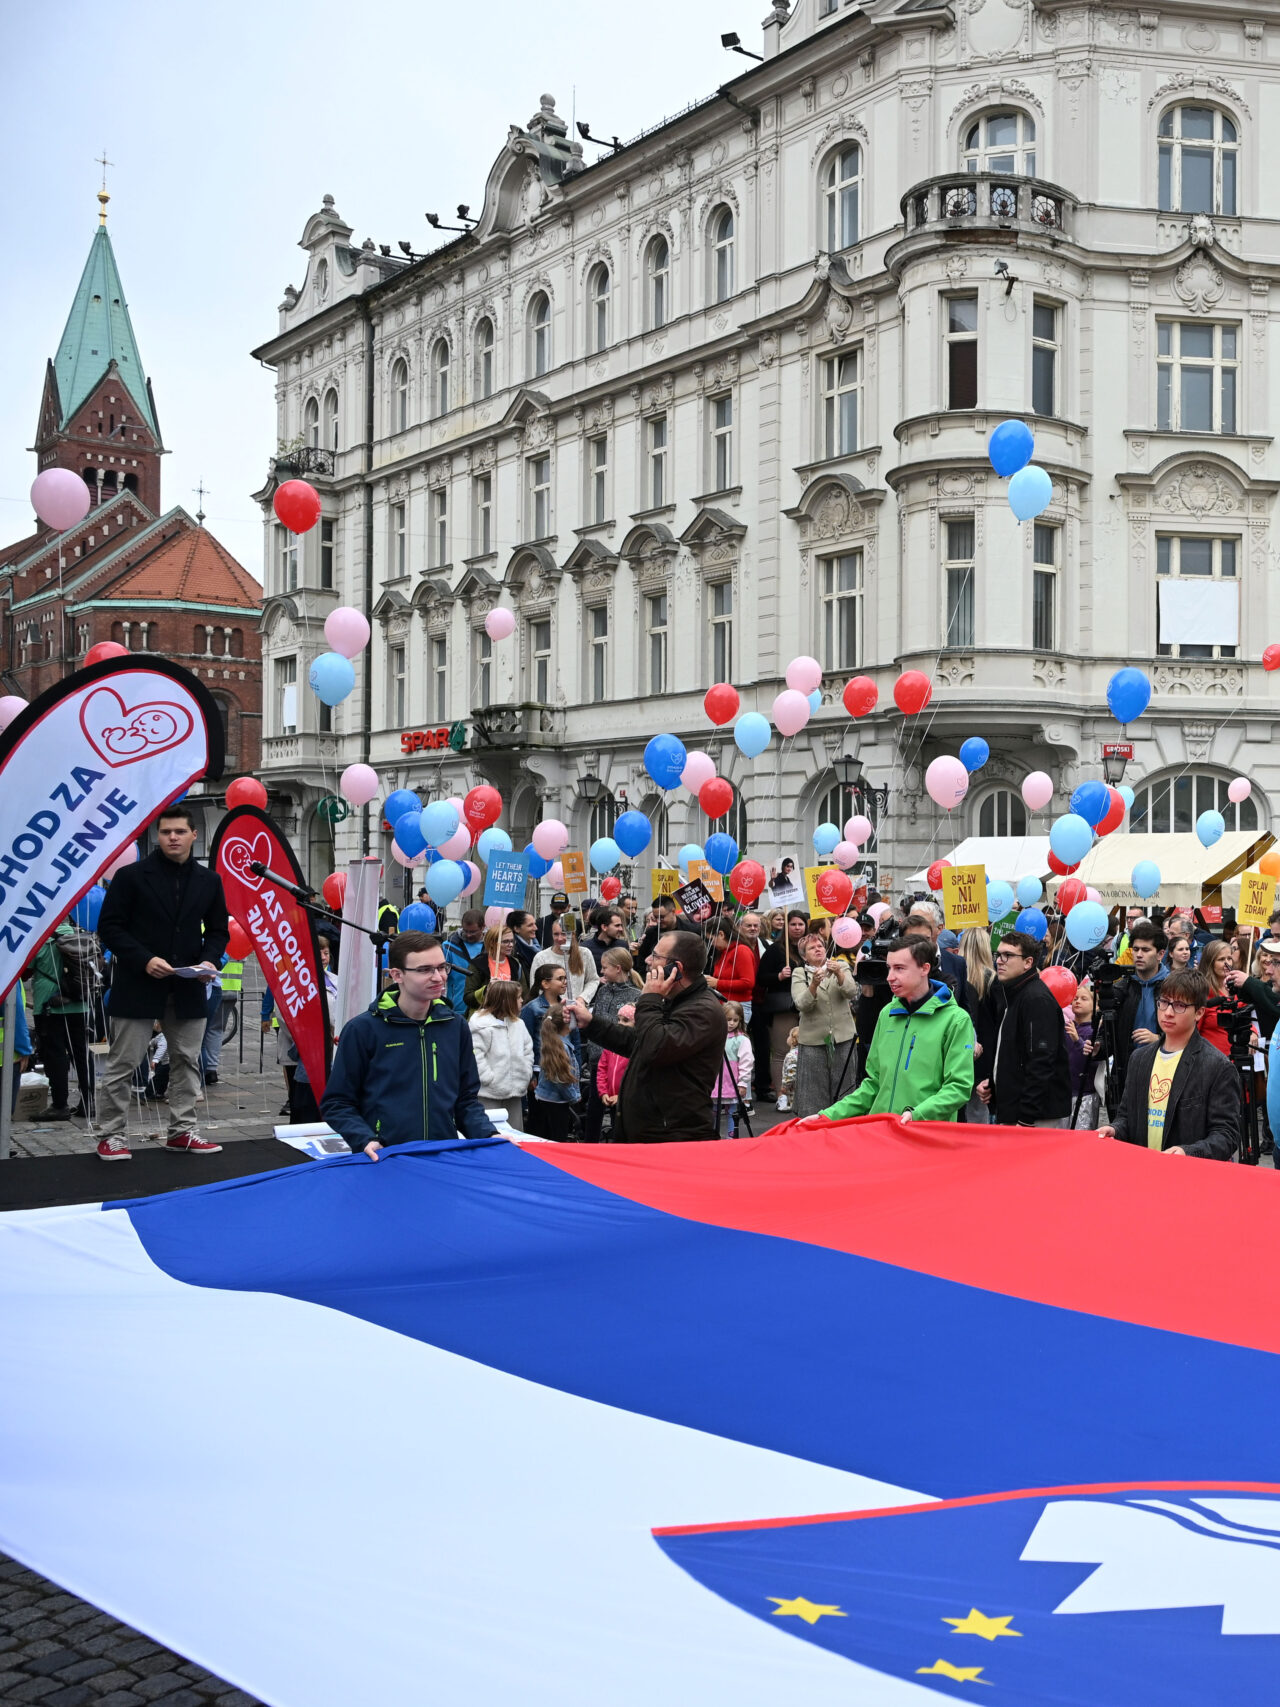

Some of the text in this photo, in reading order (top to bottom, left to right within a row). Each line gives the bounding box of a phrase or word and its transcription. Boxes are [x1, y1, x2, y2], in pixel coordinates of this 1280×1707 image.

[401, 728, 450, 753] SPAR
[0, 766, 106, 907] HOD ZA
[495, 861, 523, 871] LET THEIR
[492, 870, 523, 882] HEARTS
[951, 874, 977, 886] SPLAV
[495, 881, 517, 893] BEAT!
[1248, 880, 1269, 891] SPLAV
[958, 886, 972, 902] NI
[1251, 891, 1263, 905] NI
[952, 903, 980, 915] ZDRAV!
[1244, 904, 1268, 916] ZDRAV!
